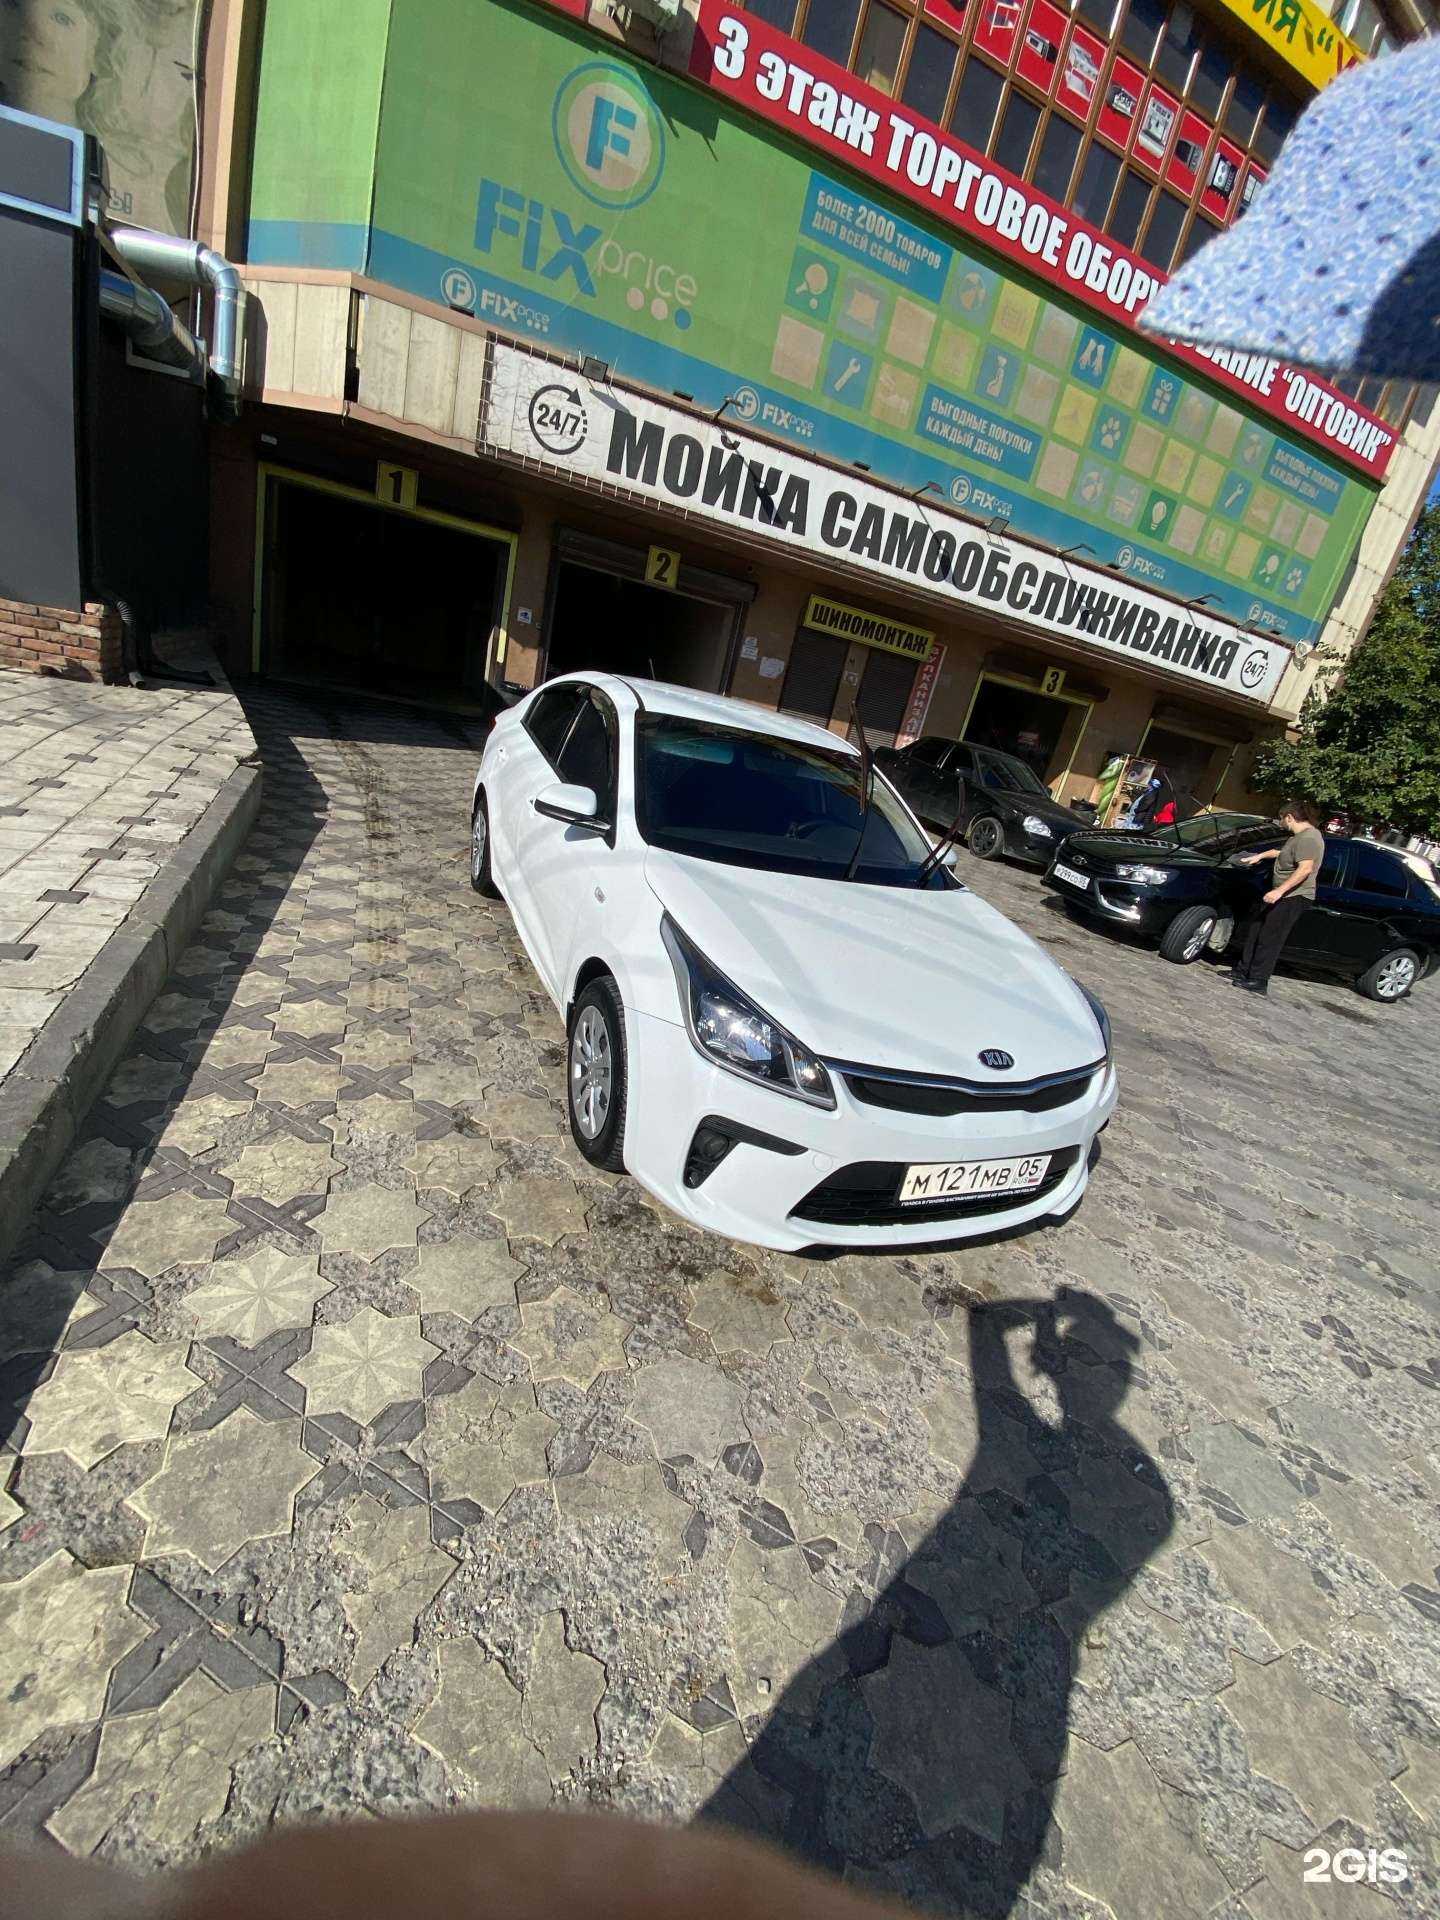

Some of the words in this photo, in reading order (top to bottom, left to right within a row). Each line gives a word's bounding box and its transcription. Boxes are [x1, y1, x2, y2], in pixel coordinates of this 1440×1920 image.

[585, 96, 638, 170] F
[714, 16, 749, 79] 3
[756, 51, 880, 157] этаж
[886, 114, 1068, 268] ТОРГОВОЕ
[1282, 368, 1391, 463] "ОПТОВИК"
[812, 211, 838, 237] ДЛЯ
[839, 224, 868, 253] ВСЕЙ
[870, 241, 911, 275] СЕМЬИ!
[817, 190, 854, 222] БОЛЕЕ
[855, 205, 896, 243] 2000
[896, 233, 941, 269] ТОВАРОВ
[537, 403, 581, 436] 24/7
[926, 416, 974, 449] КАЖДЫЙ
[973, 439, 1004, 462] ДЕНЬ!
[931, 397, 988, 434] ВЫГОДНЫЕ
[988, 424, 1032, 454] ПОКУПКИ
[389, 471, 402, 503] 1
[606, 408, 811, 536] МОЙКА
[820, 491, 1240, 680] САМООБСЛУЖИВАНИЯ
[654, 553, 672, 583] 2
[812, 603, 929, 654] ШИНОМОНТАЖ
[1047, 671, 1060, 692] 3
[1244, 661, 1265, 678] 24/7
[1018, 1159, 1042, 1177] 05
